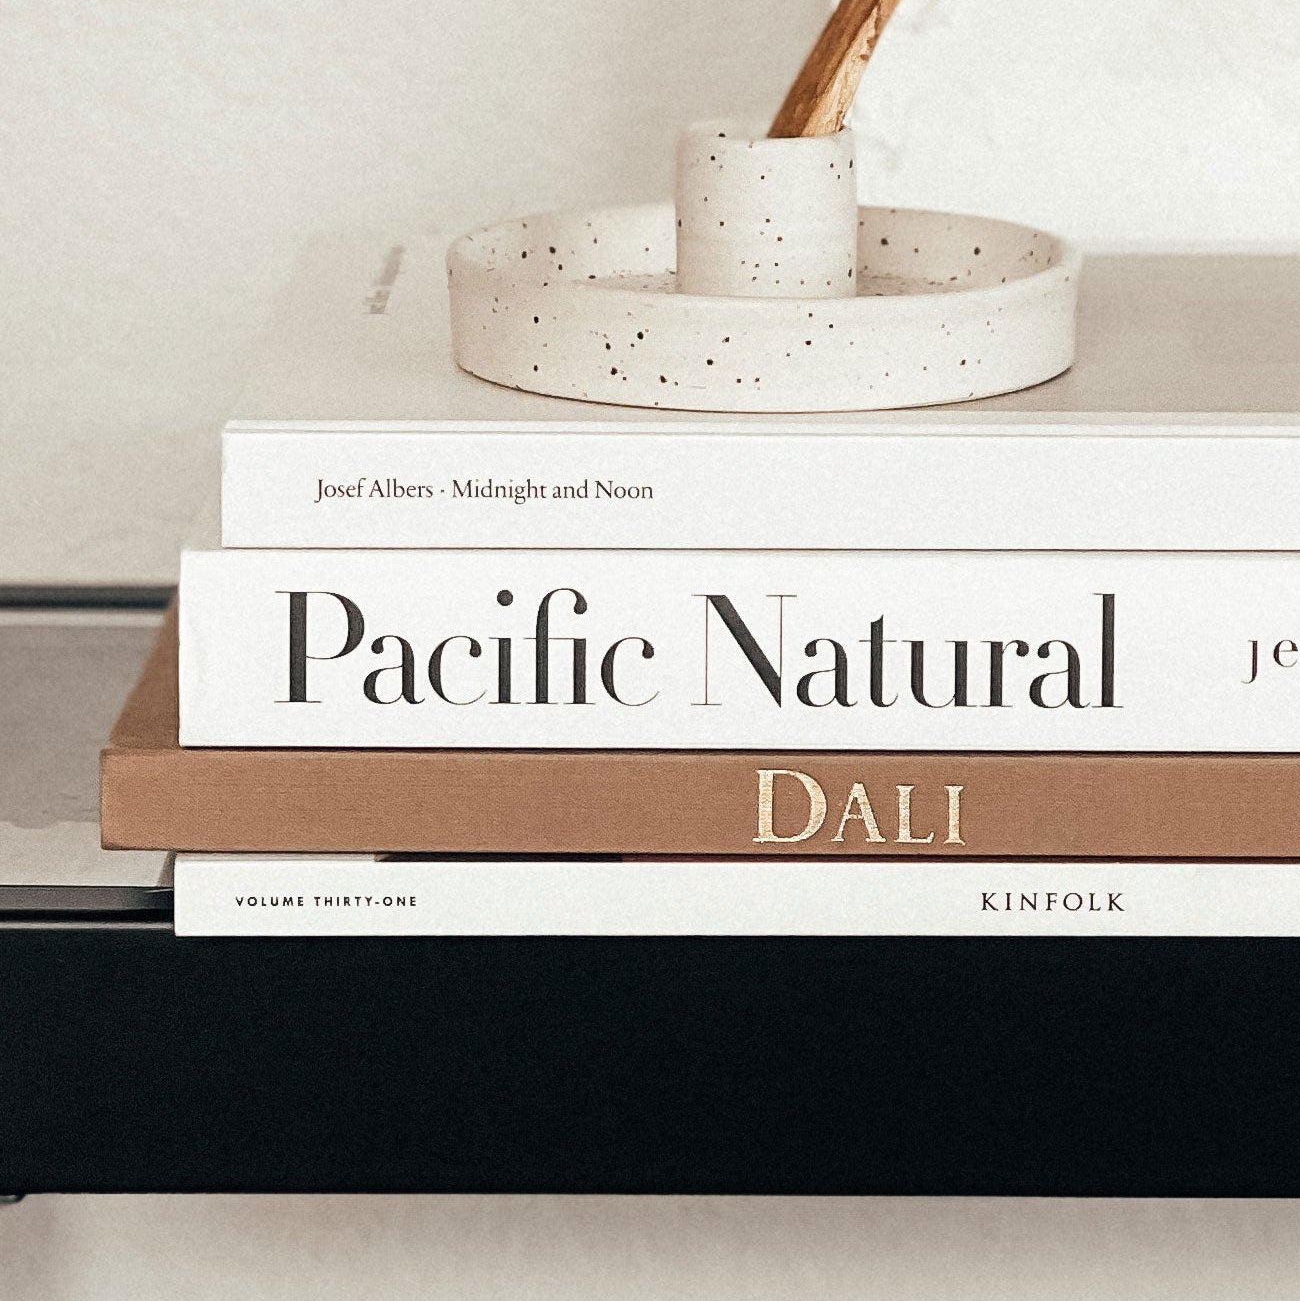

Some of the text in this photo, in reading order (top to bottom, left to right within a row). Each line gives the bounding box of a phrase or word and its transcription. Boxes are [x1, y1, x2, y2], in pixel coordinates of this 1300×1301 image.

[314, 478, 367, 503] Josef
[370, 478, 434, 499] Albers
[452, 478, 547, 505] Midnight
[551, 478, 589, 499] and
[594, 480, 654, 500] Noon
[274, 587, 1124, 710] Pacific Natural
[752, 768, 966, 845] DALI
[235, 895, 417, 907] VOLUME THIRTY-ONE
[981, 892, 1126, 912] KINFOLK
